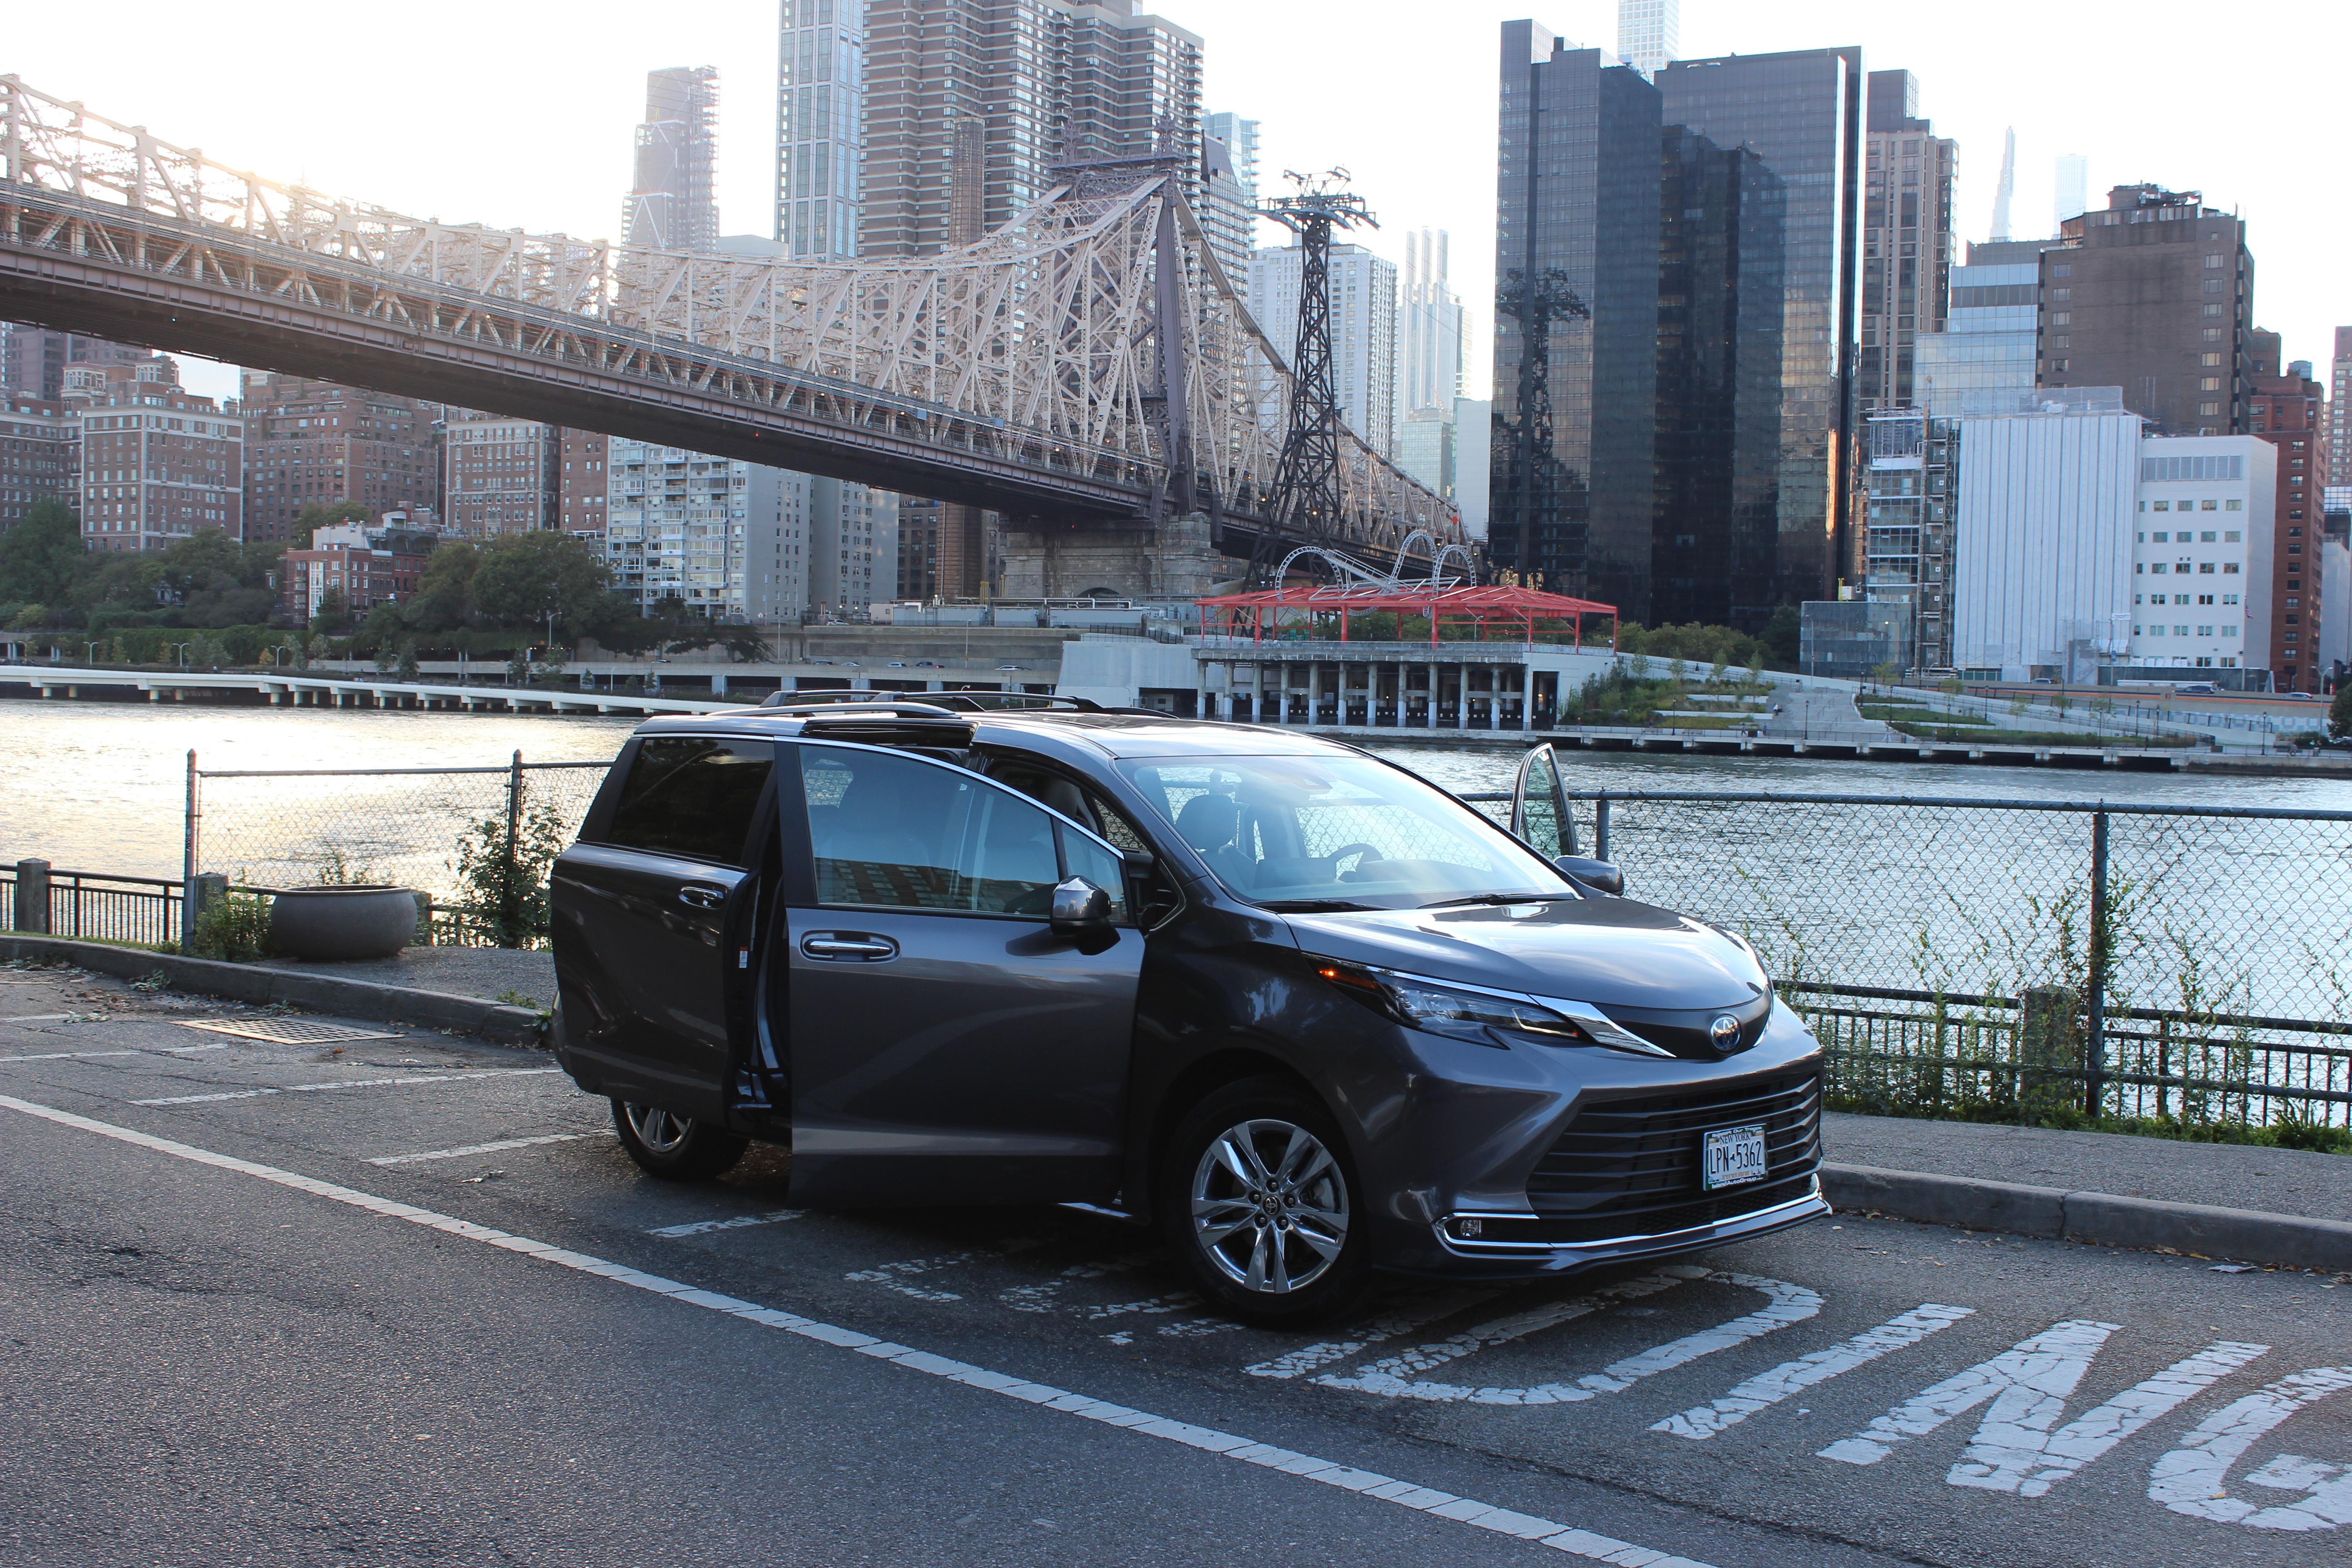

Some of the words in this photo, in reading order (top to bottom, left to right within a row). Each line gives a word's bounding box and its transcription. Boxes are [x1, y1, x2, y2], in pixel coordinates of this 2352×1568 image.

[1720, 1134, 1734, 1144] NEW
[1734, 1132, 1750, 1142] YORK
[1709, 1145, 1729, 1174] LPN
[1736, 1139, 1762, 1169] 5362
